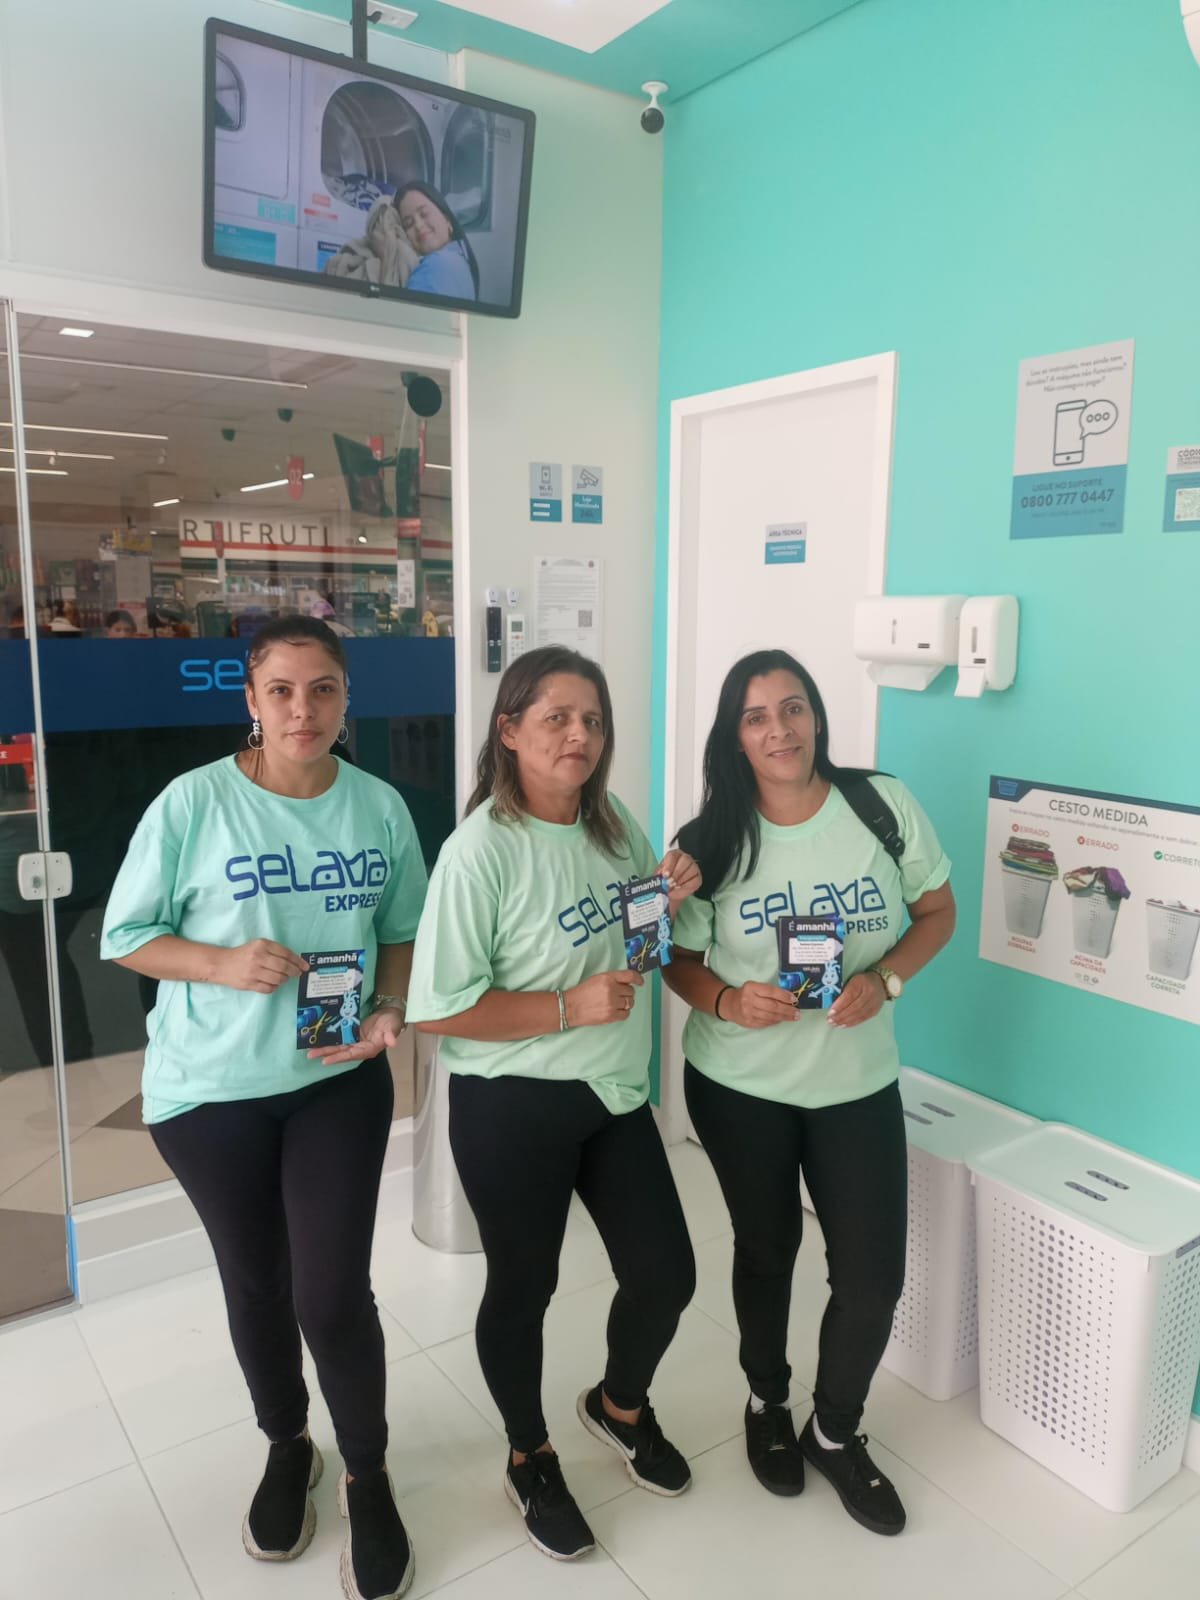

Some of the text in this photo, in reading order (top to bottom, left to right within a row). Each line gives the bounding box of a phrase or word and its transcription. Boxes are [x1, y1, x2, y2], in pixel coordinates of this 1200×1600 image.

[1021, 488, 1115, 508] 0800 777 0447
[1048, 799, 1090, 817] CESTO
[1093, 806, 1148, 827] MEDIDA
[1020, 825, 1050, 837] ERRADO
[1086, 838, 1119, 852] ERRADO
[631, 877, 661, 895] amanhã
[788, 920, 835, 932] É amanhã
[309, 952, 357, 965] É amanhã
[1146, 974, 1187, 990] CAPACIDADE
